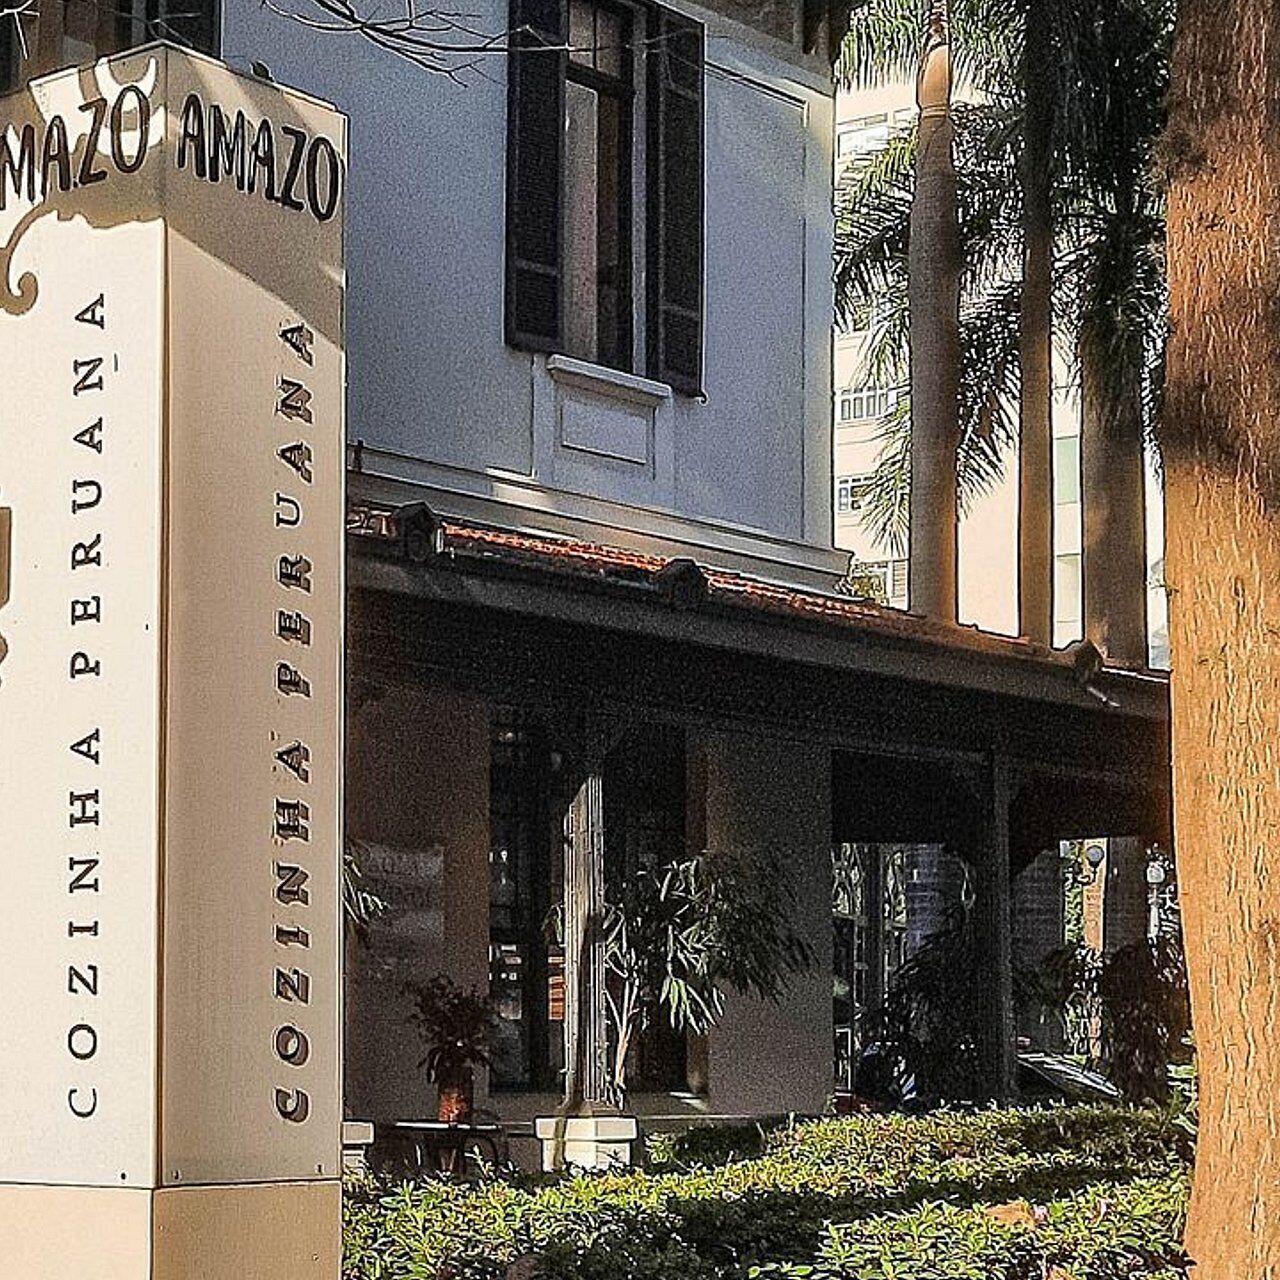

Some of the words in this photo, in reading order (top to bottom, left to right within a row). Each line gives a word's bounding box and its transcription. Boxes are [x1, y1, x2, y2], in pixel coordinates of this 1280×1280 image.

[176, 94, 341, 221] AMAZO
[70, 294, 106, 678] PERUANA
[275, 321, 314, 698] PERUANA
[67, 728, 103, 1117] COZINHA
[274, 741, 311, 1123] COZINHA
